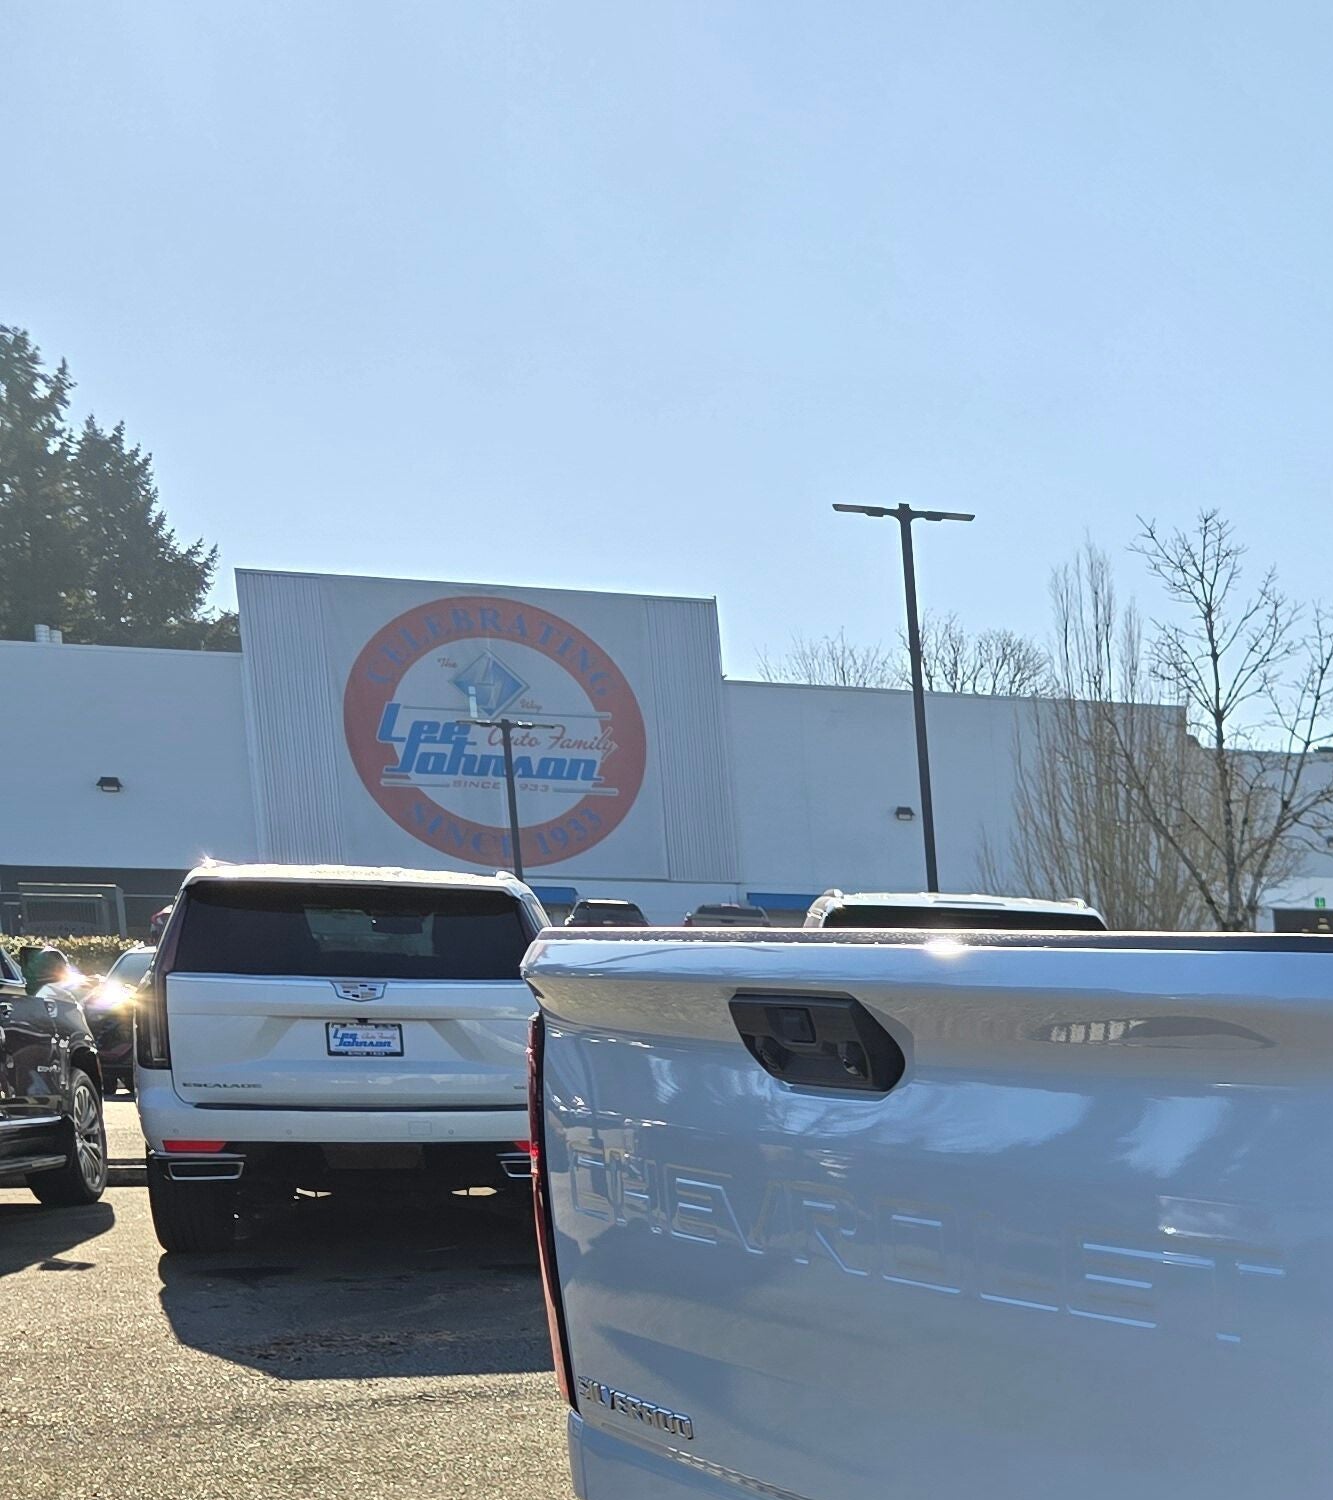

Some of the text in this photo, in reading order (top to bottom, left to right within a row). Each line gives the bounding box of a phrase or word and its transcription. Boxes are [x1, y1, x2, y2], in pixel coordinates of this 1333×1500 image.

[367, 606, 617, 697] CELEBRATING
[377, 702, 476, 746] Lee
[548, 725, 618, 760] Family
[384, 738, 604, 782] Johnson
[452, 779, 551, 793] SINCE 933
[535, 807, 604, 856] 1933
[569, 1141, 1285, 1343] CHEVROLET
